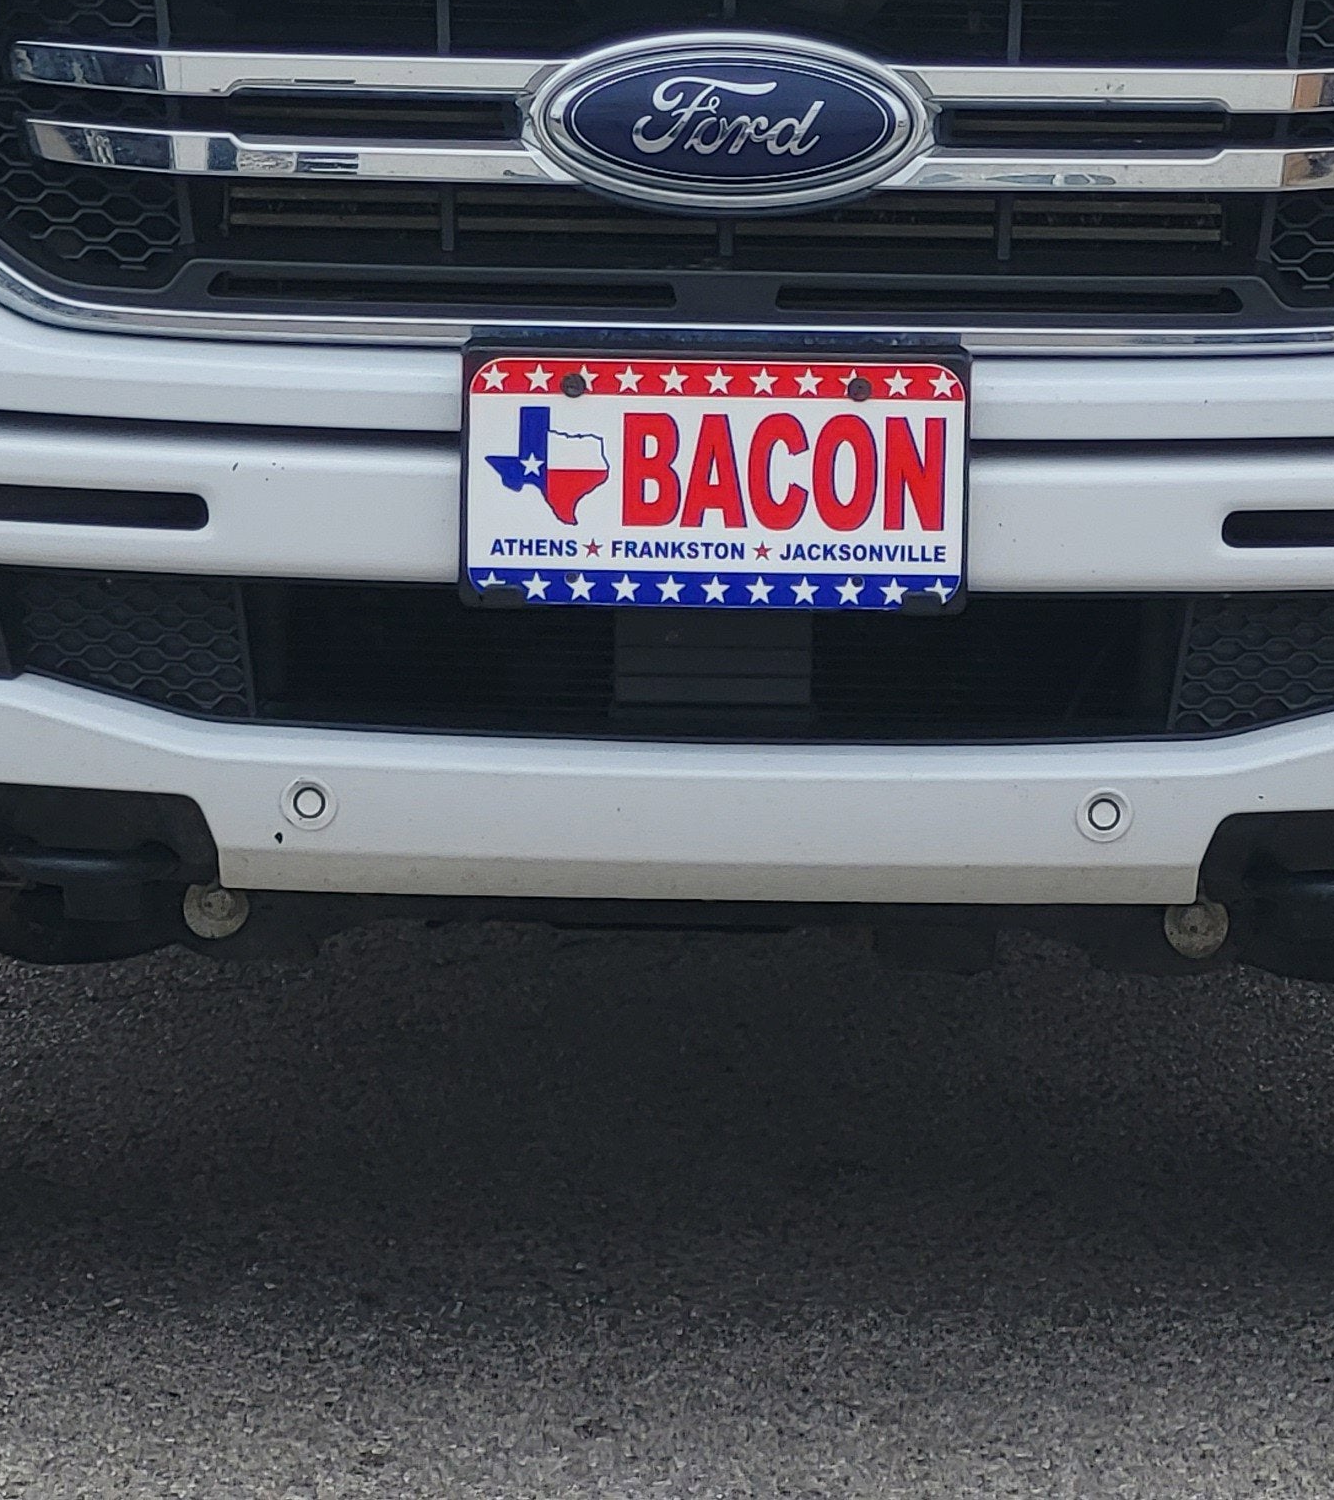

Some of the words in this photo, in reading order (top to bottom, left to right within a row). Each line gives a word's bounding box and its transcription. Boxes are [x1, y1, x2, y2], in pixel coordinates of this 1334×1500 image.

[632, 75, 825, 156] Ford
[621, 411, 948, 533] BACON
[490, 538, 578, 558] ATHENS
[611, 539, 746, 561] FRANKSTON
[779, 543, 947, 563] JACKSONVILLE
